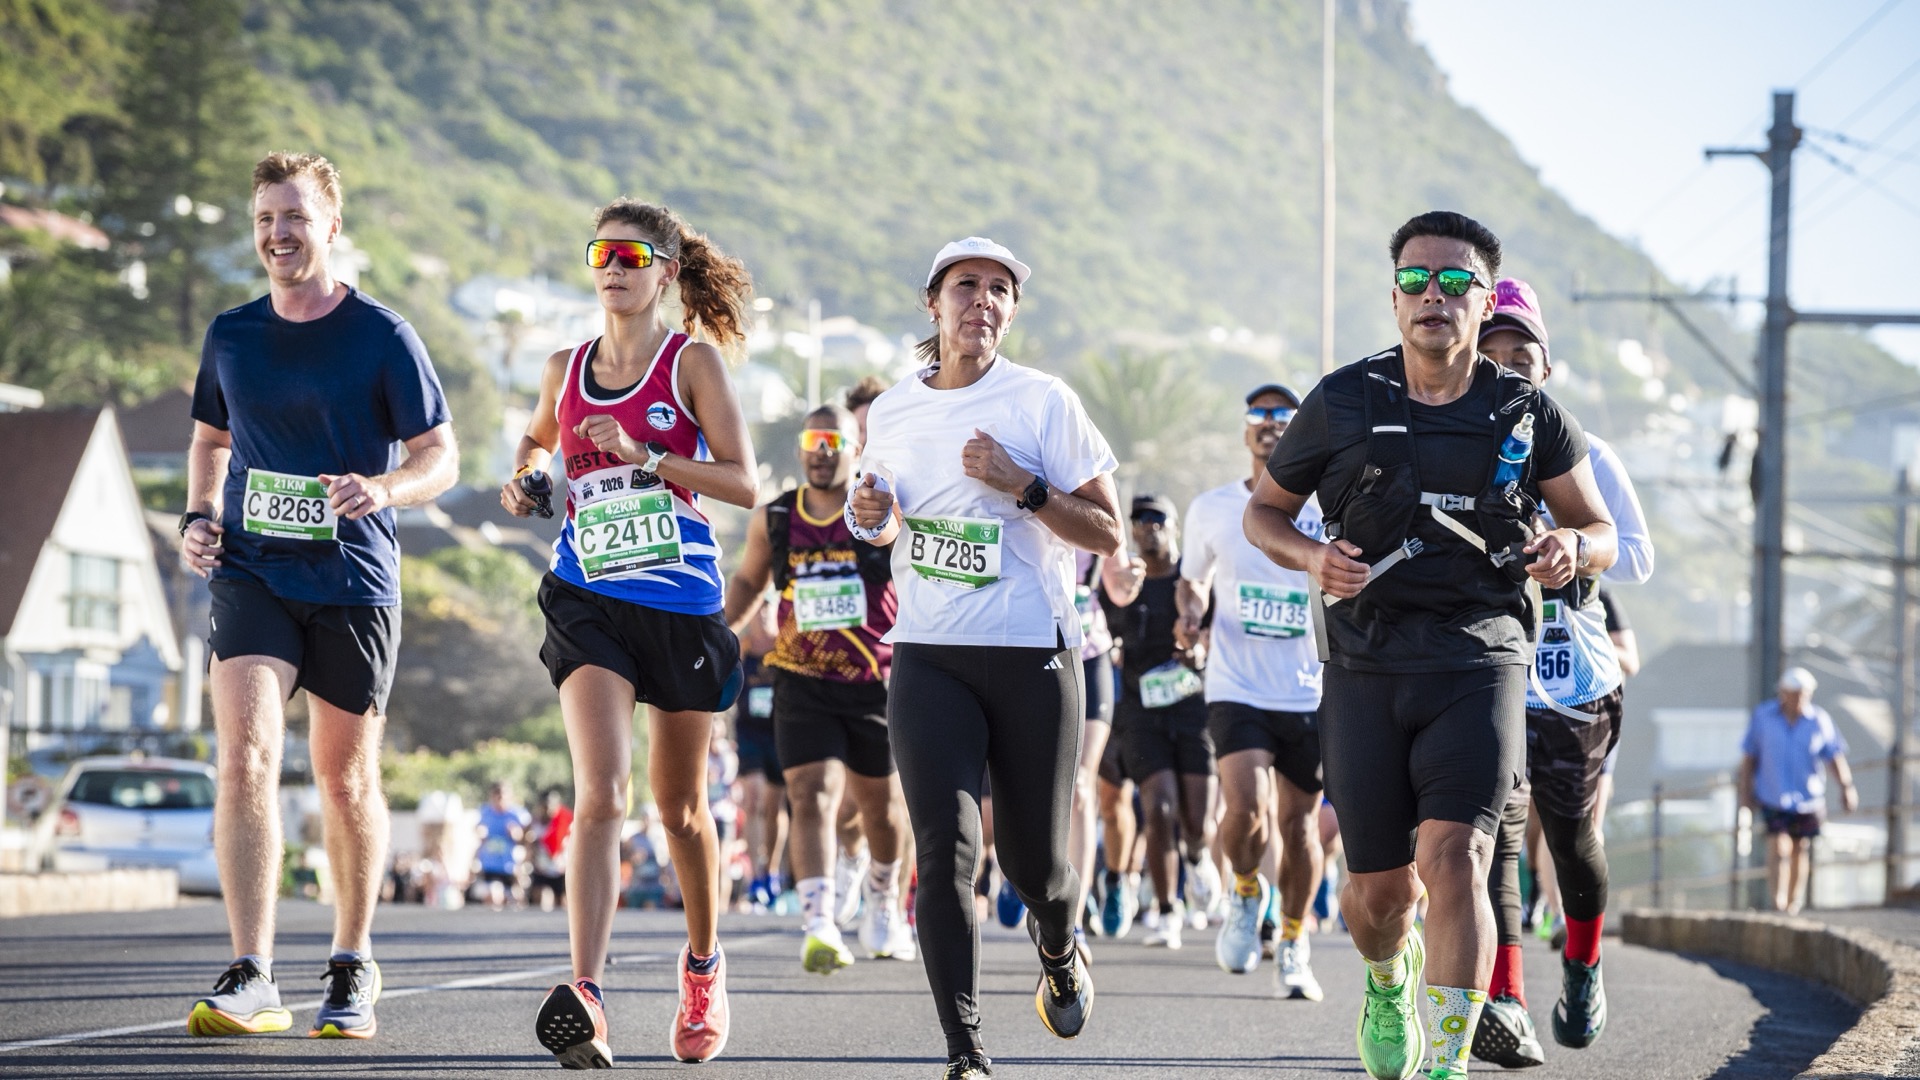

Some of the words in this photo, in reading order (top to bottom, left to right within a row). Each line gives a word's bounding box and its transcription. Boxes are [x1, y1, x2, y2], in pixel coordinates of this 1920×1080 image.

[565, 451, 600, 473] WEST
[273, 478, 306, 492] 21KM
[600, 476, 624, 493] 2026
[633, 470, 657, 482] ASA
[248, 492, 262, 517] C
[267, 495, 325, 525] 8263
[604, 498, 641, 515] 42KM
[580, 527, 596, 555] C
[603, 513, 675, 551] 2410
[932, 520, 965, 535] 21KM
[911, 532, 926, 562] B
[933, 536, 987, 573] 7285
[800, 599, 808, 618] C
[815, 595, 857, 616] 8486
[1240, 597, 1307, 625] E10135
[1546, 628, 1568, 638] ASA
